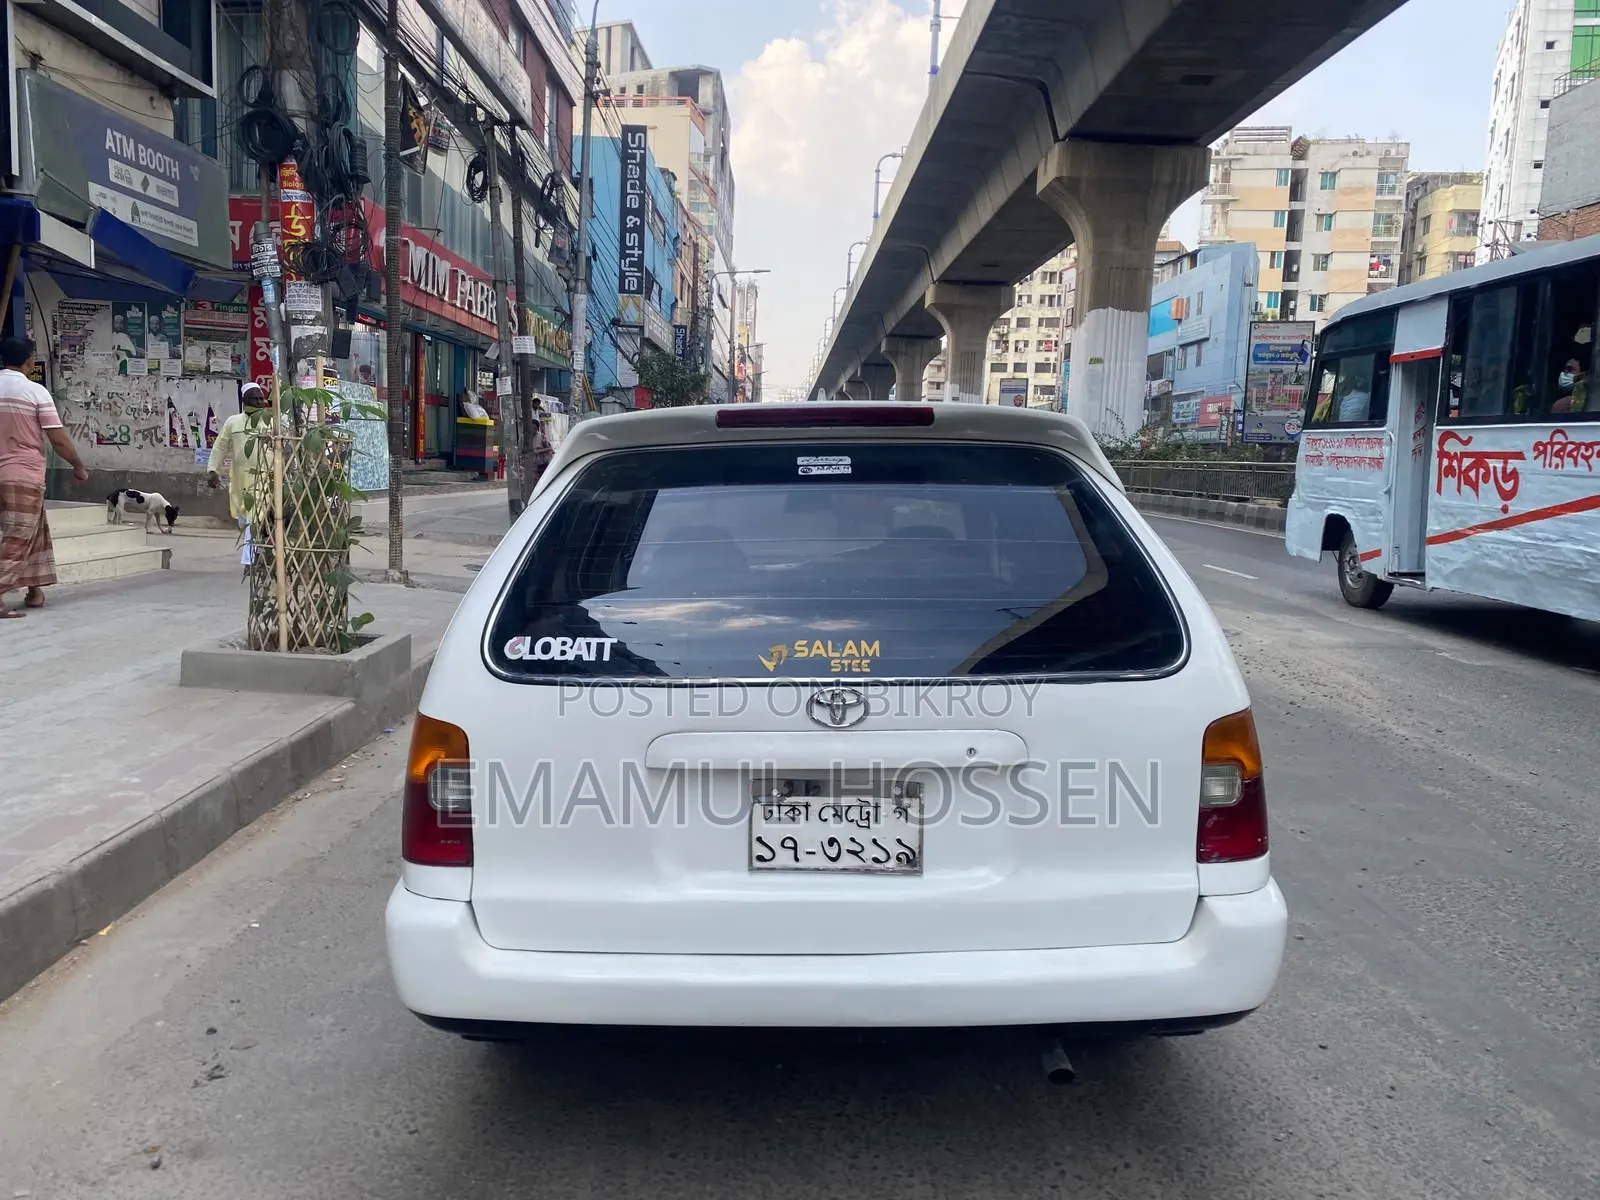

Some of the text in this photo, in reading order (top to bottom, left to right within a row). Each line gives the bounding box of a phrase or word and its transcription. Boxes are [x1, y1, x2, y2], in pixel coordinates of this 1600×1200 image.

[105, 127, 135, 161] ATM
[138, 143, 180, 180] BOOTH
[626, 132, 645, 208] Shade
[625, 216, 641, 228] &
[401, 238, 450, 302] MIM
[214, 302, 247, 314] Fingers
[1436, 430, 1526, 514] শিকড়
[504, 636, 617, 661] GLOBATT
[793, 640, 880, 658] SALAM
[760, 799, 911, 829] ঢাকা মেট্রো গ
[756, 836, 916, 864] ১৭-৩২১৯
